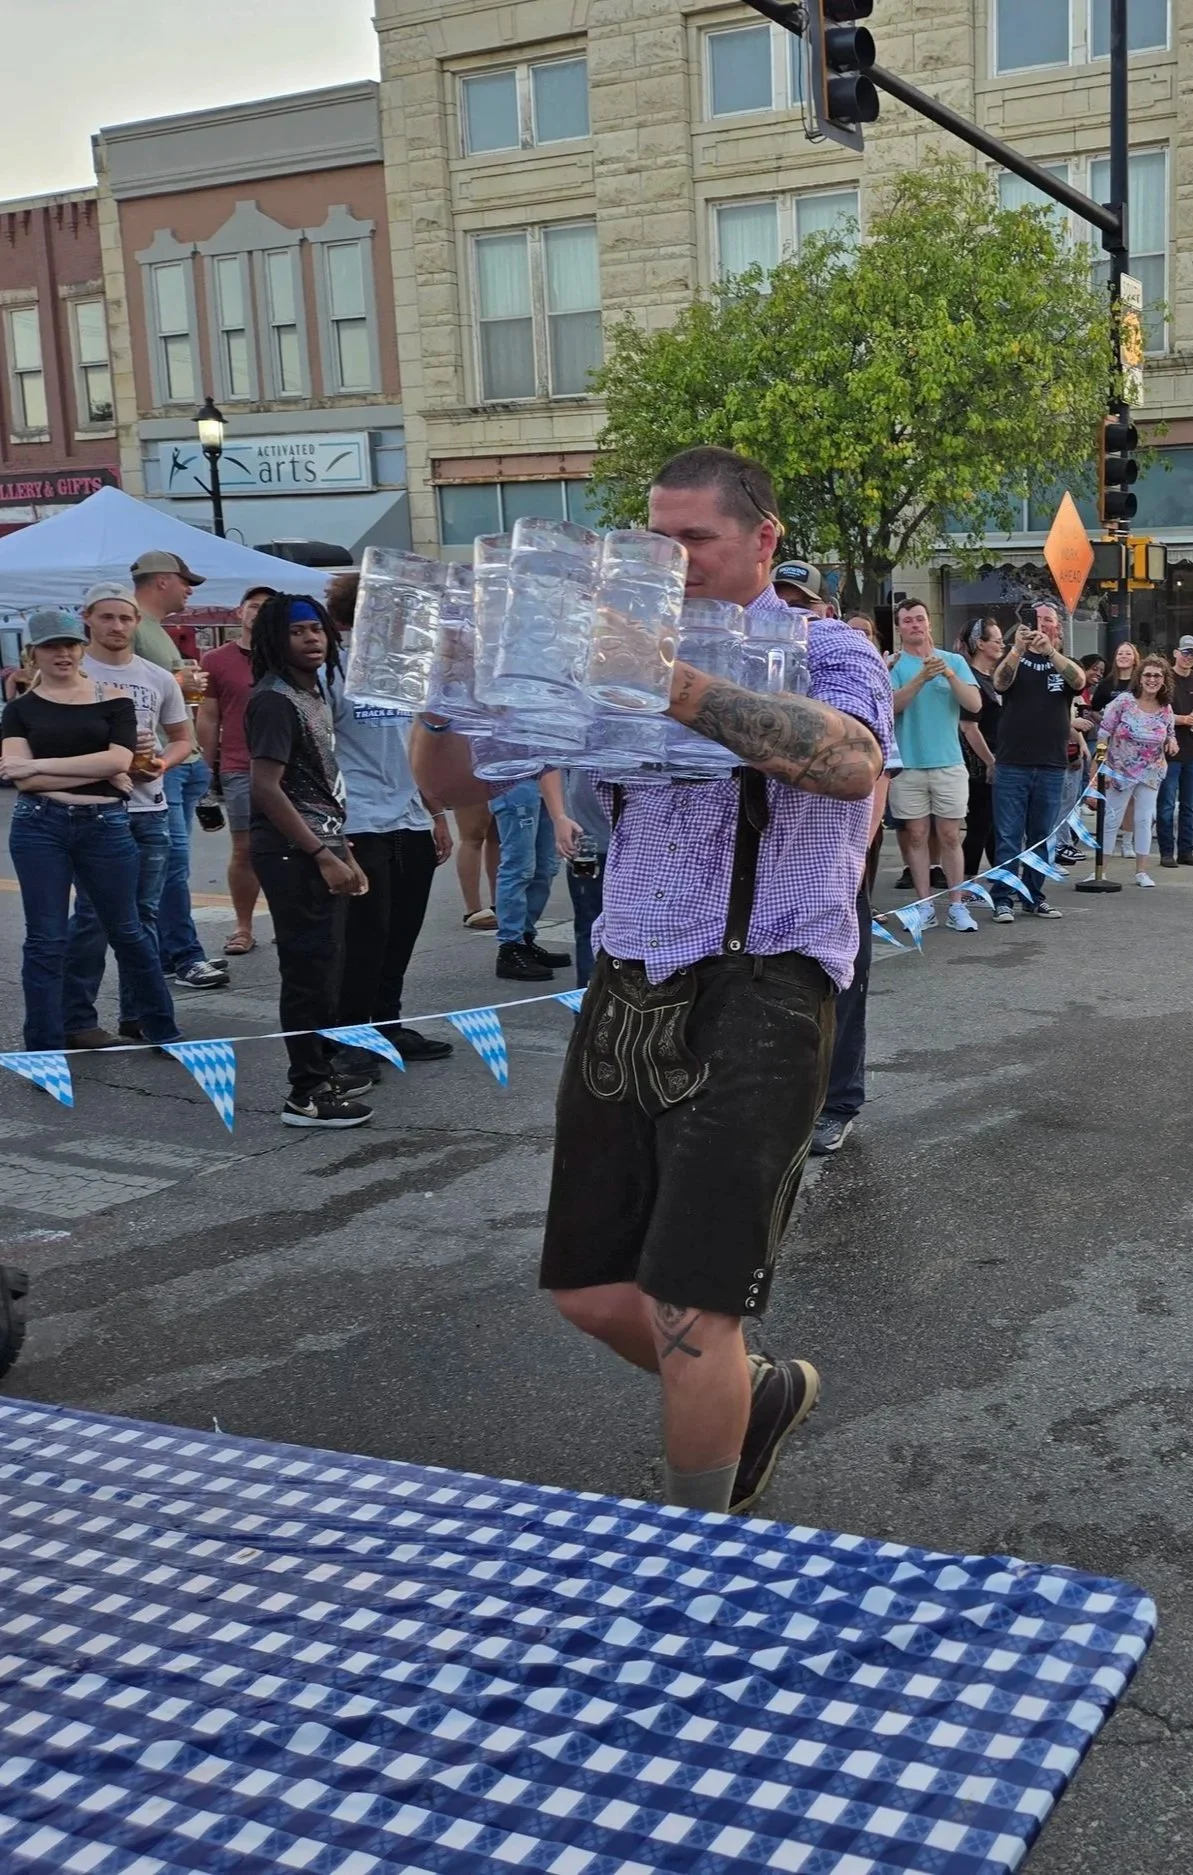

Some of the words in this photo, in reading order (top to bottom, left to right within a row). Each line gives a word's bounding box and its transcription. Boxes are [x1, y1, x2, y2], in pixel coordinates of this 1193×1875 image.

[256, 444, 316, 457] ACTIVATED
[259, 457, 317, 484] arts
[44, 481, 55, 498] &
[57, 477, 102, 495] GIFTS
[355, 710, 385, 718] TRACK
